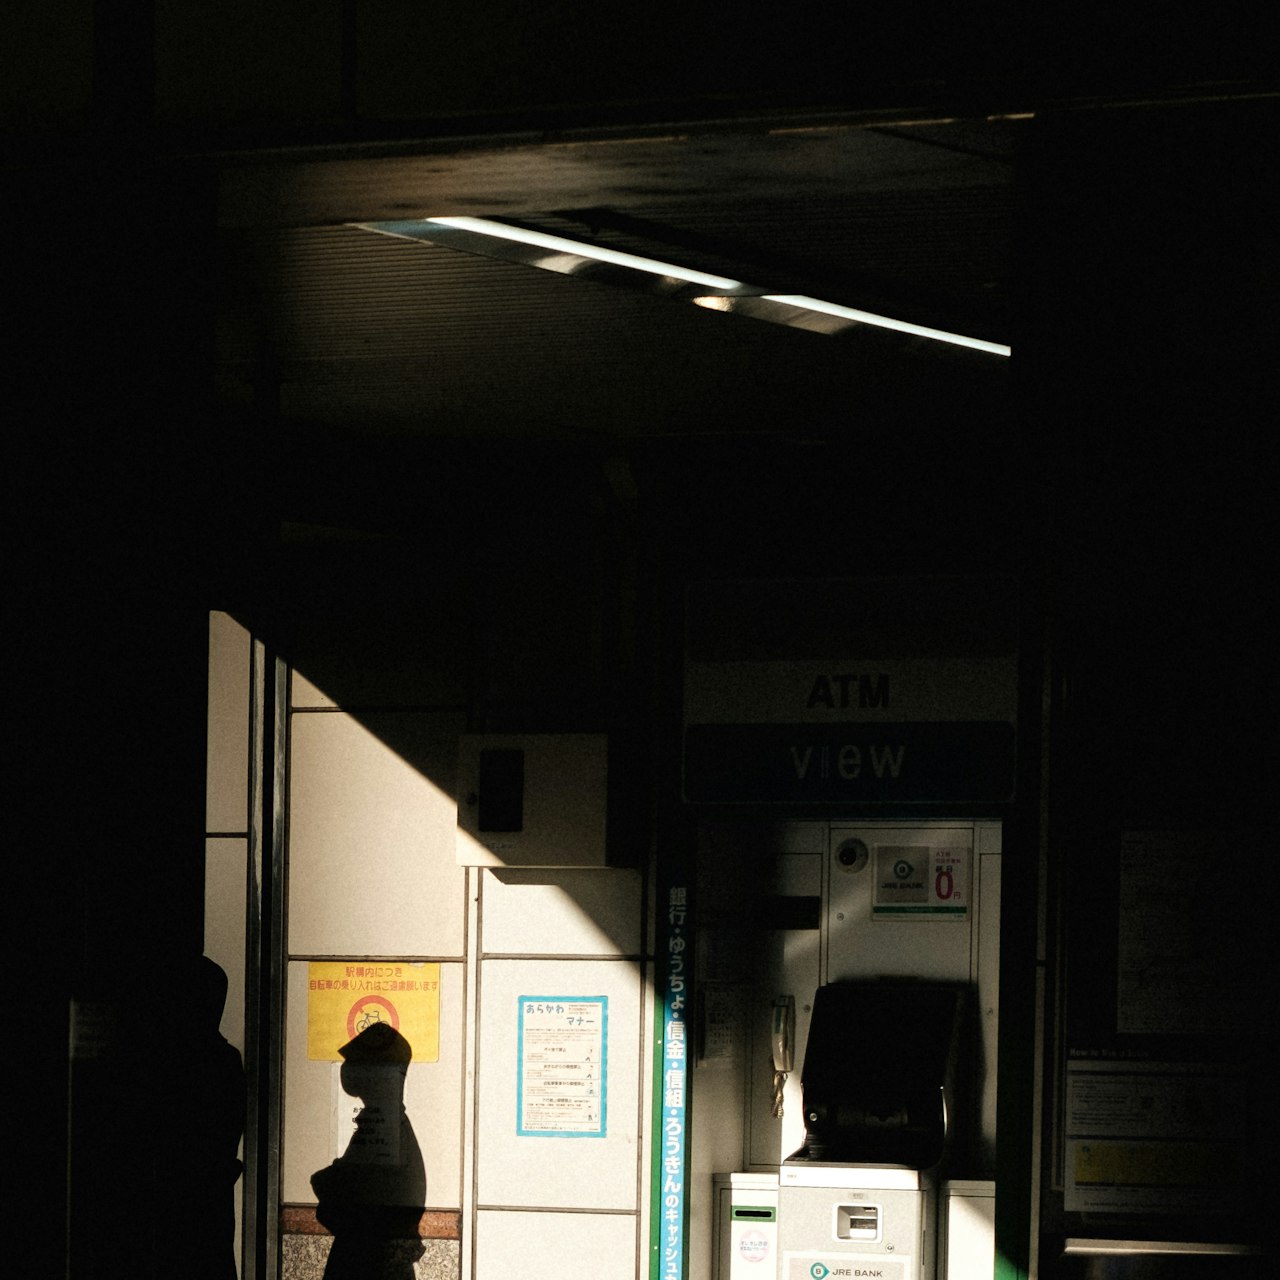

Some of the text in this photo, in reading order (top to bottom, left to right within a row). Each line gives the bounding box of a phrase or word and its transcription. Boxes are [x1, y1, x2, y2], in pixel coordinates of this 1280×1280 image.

[807, 674, 890, 708] ATM
[345, 966, 403, 978] 駅構内につき
[526, 1003, 565, 1015] あらかわ
[566, 1016, 595, 1026] マナー
[832, 1268, 851, 1277] JRE
[854, 1269, 884, 1278] BANK
